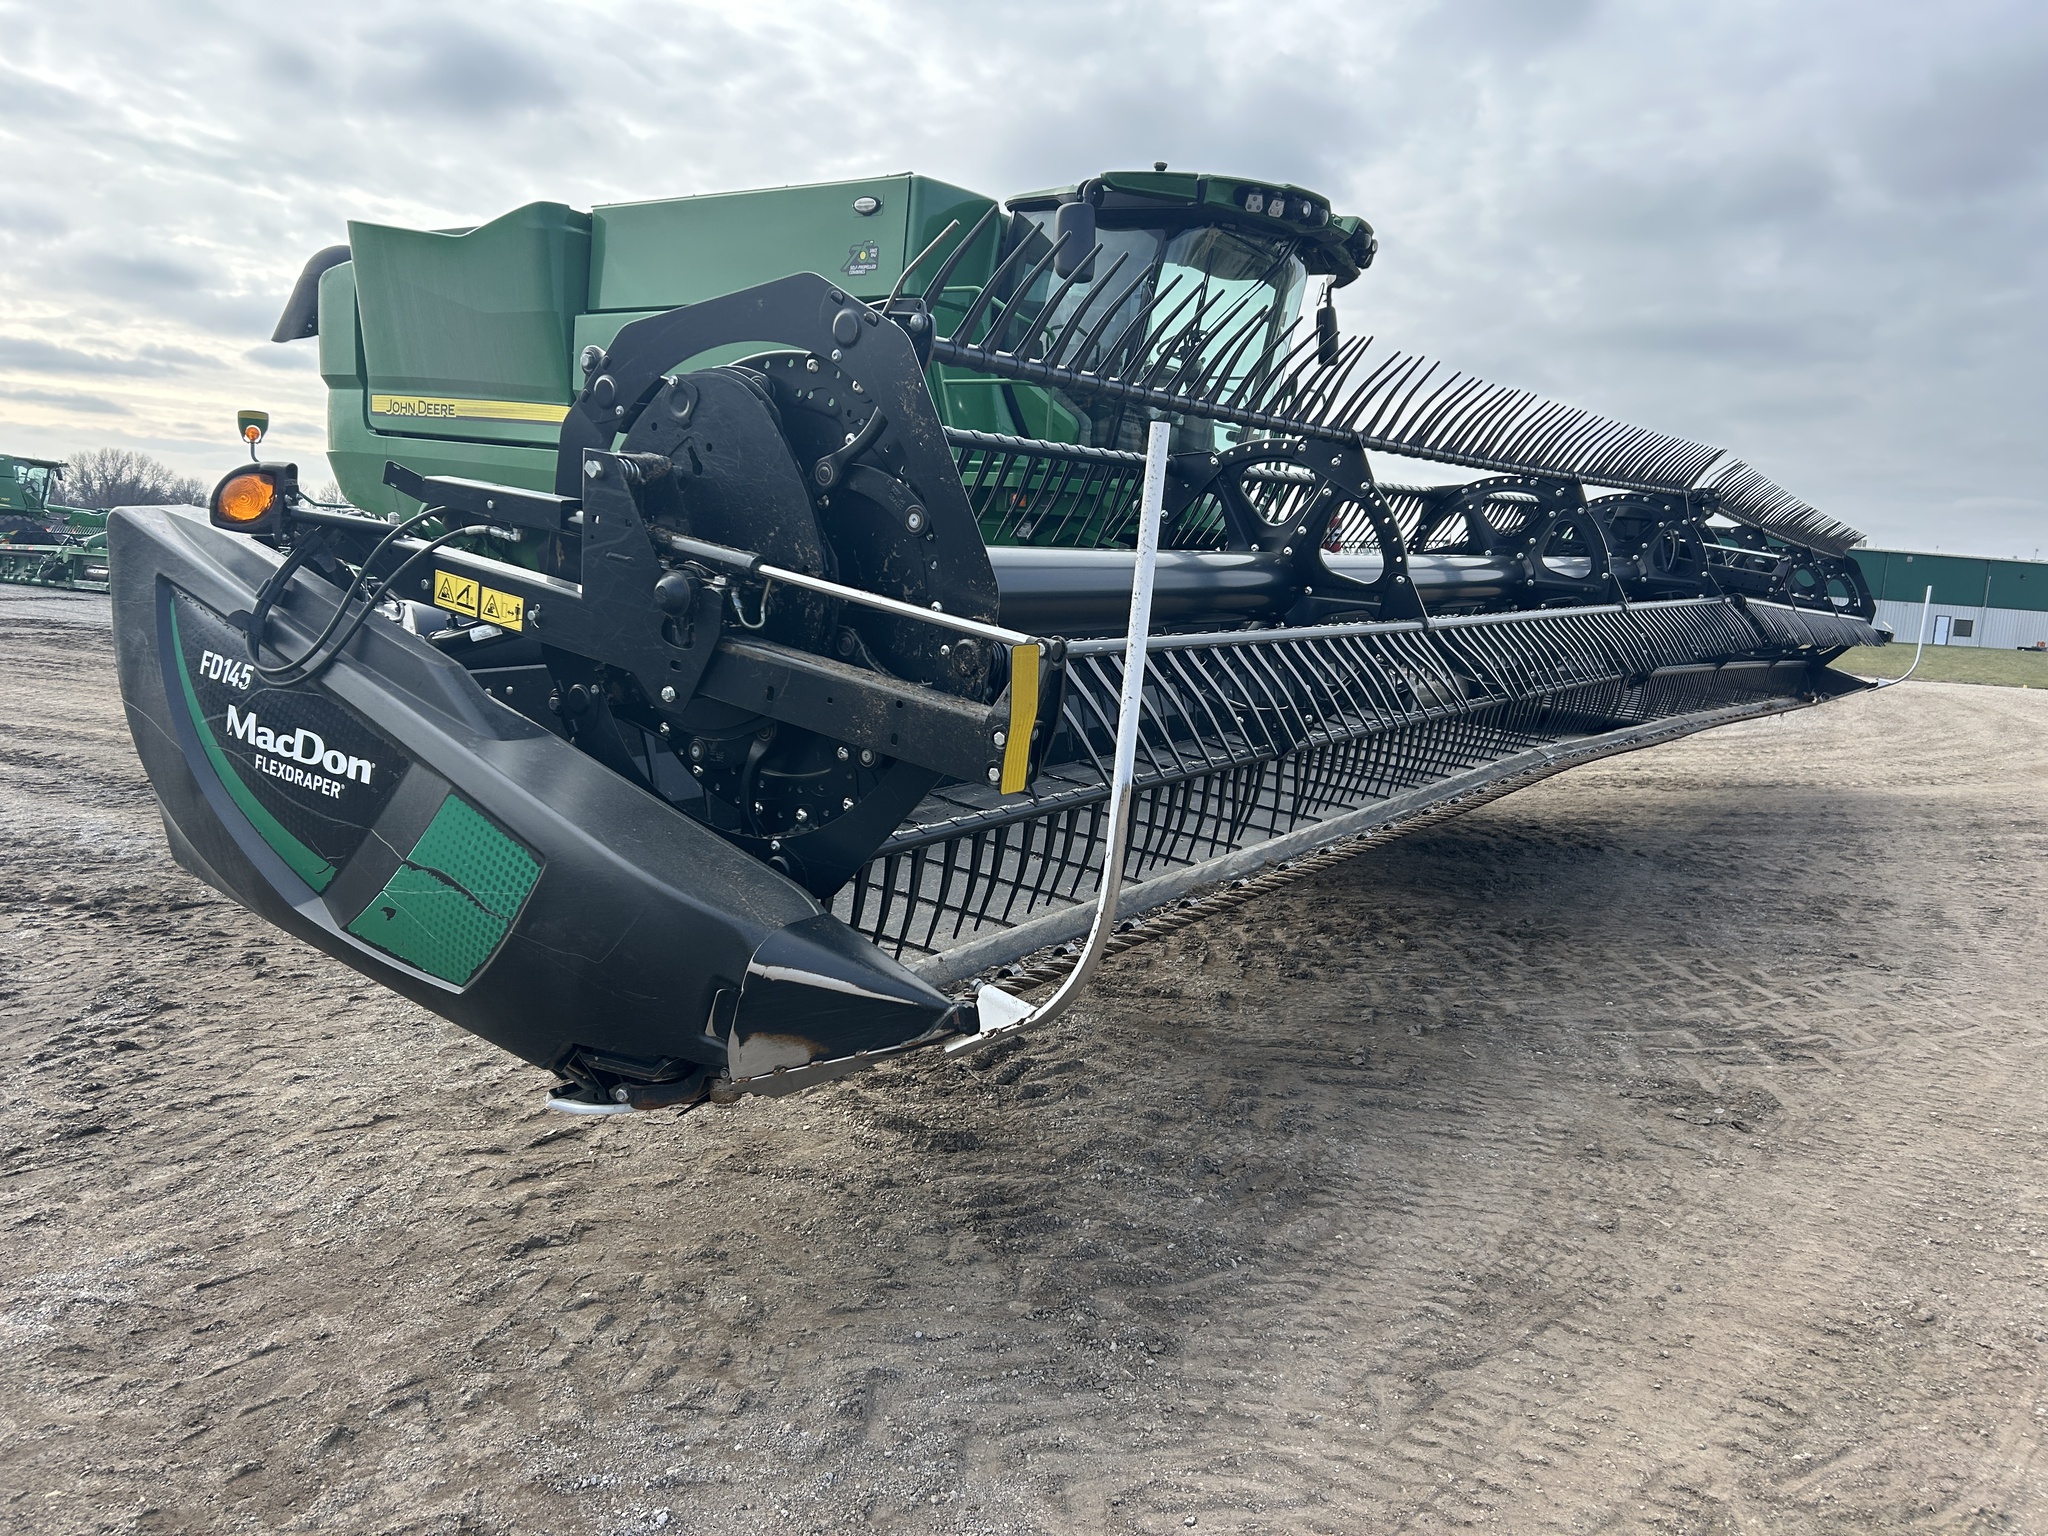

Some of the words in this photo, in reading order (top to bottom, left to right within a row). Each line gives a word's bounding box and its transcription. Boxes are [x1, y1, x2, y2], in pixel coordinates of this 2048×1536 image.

[386, 399, 416, 414] JOHN
[418, 400, 455, 416] DEERE
[200, 650, 254, 690] FD145
